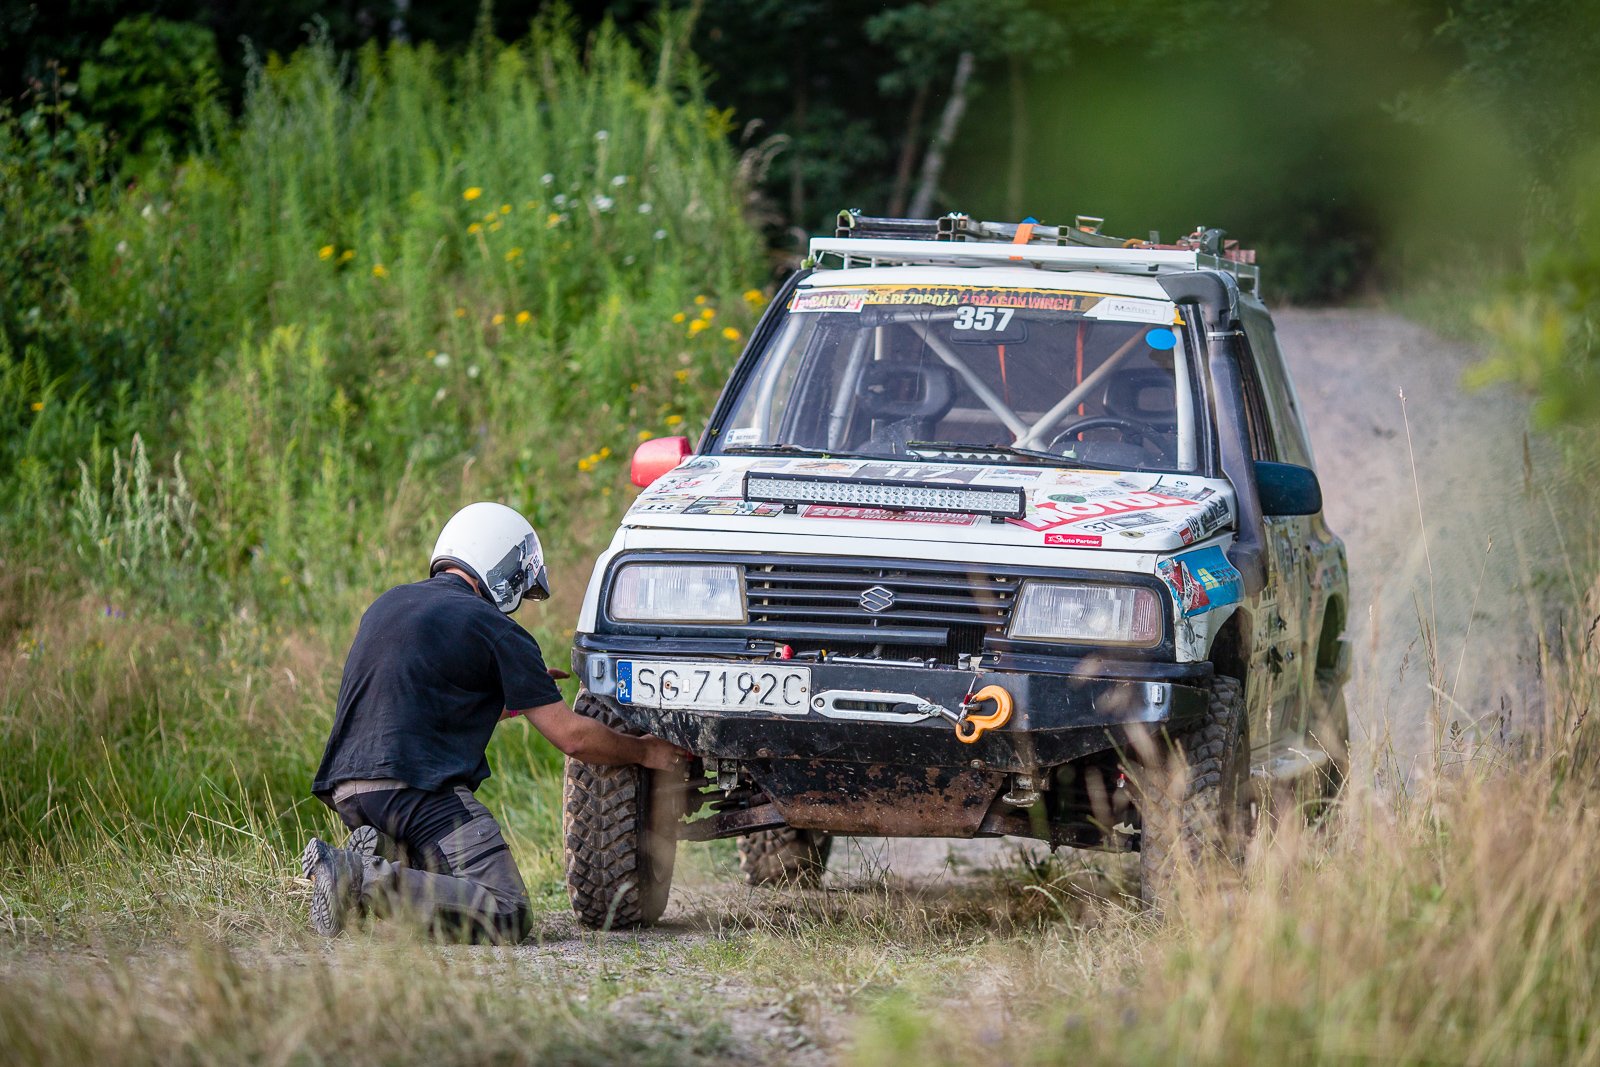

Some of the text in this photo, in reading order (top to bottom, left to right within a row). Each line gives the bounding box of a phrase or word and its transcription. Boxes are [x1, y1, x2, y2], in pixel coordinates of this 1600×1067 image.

[970, 295, 1027, 308] DRAGON
[1028, 297, 1074, 311] WINCH
[953, 305, 1015, 331] 357
[811, 507, 859, 518] 204
[1023, 493, 1190, 529] MOTUL
[1083, 521, 1114, 532] 37
[1060, 536, 1076, 544] Auto
[620, 689, 630, 698] PL
[638, 668, 801, 706] SG 7192C
